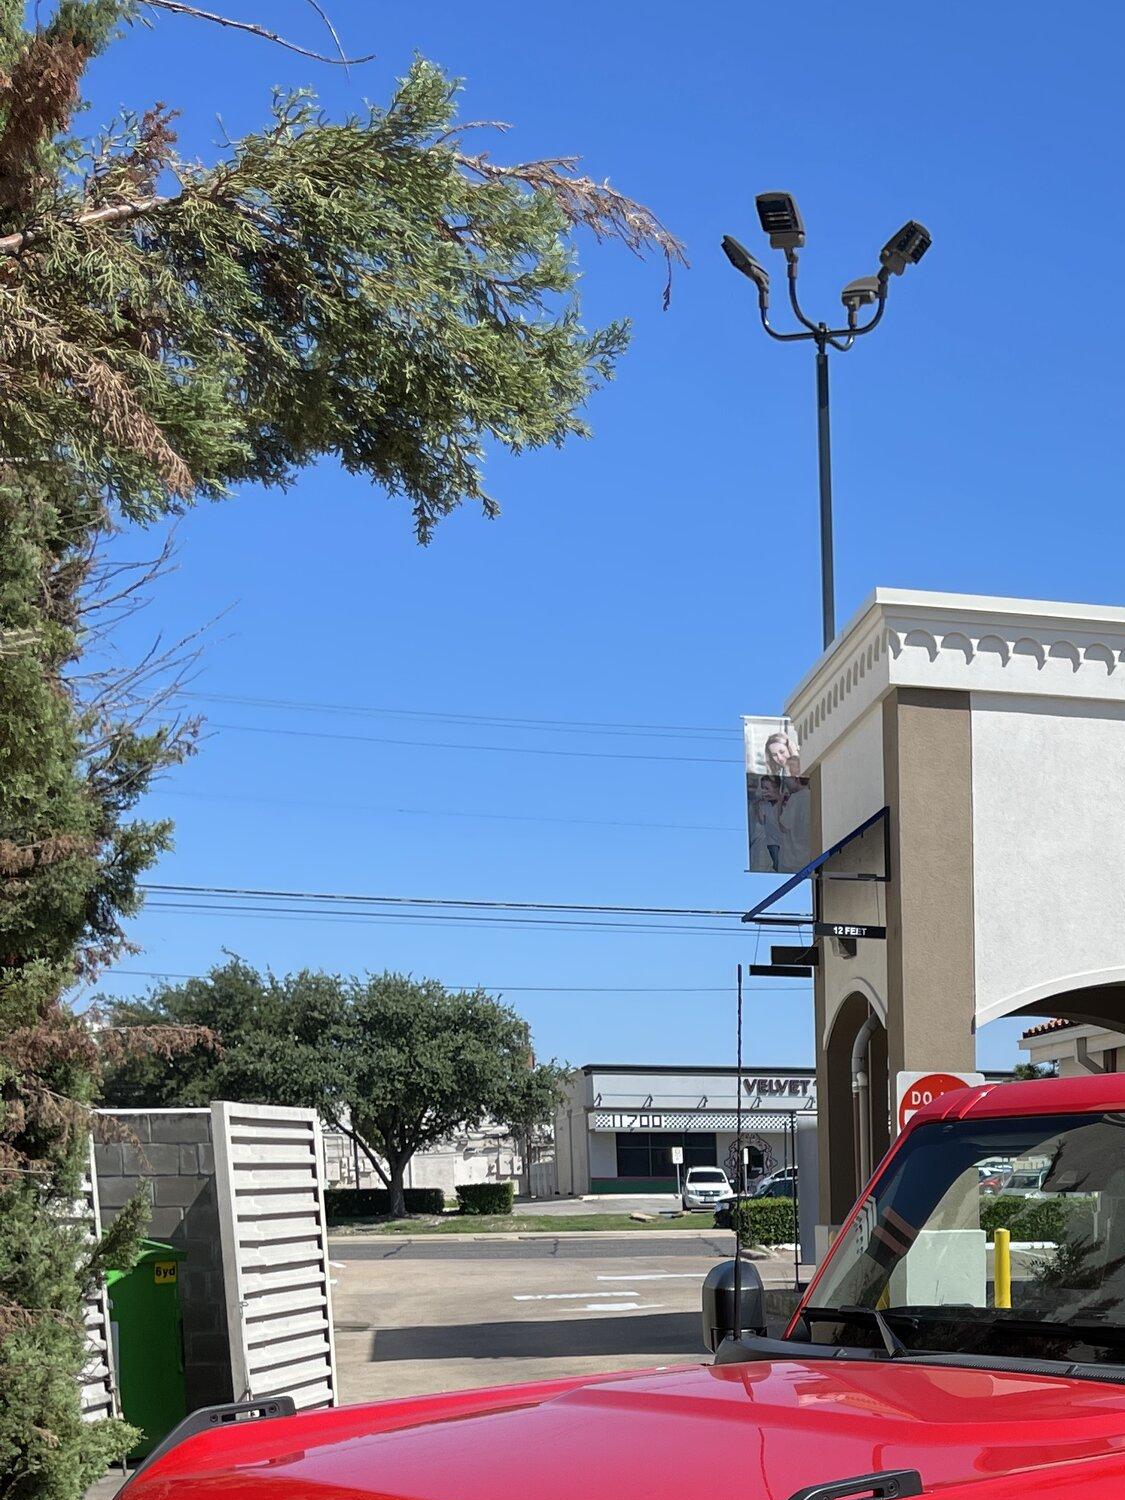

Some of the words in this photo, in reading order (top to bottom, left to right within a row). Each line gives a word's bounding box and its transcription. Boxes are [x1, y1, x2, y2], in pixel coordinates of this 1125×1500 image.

[833, 926, 844, 935] 12
[845, 926, 867, 936] FEET
[743, 1079, 811, 1097] VELVET
[911, 1091, 933, 1105] DO
[156, 1266, 175, 1278] 6yd
